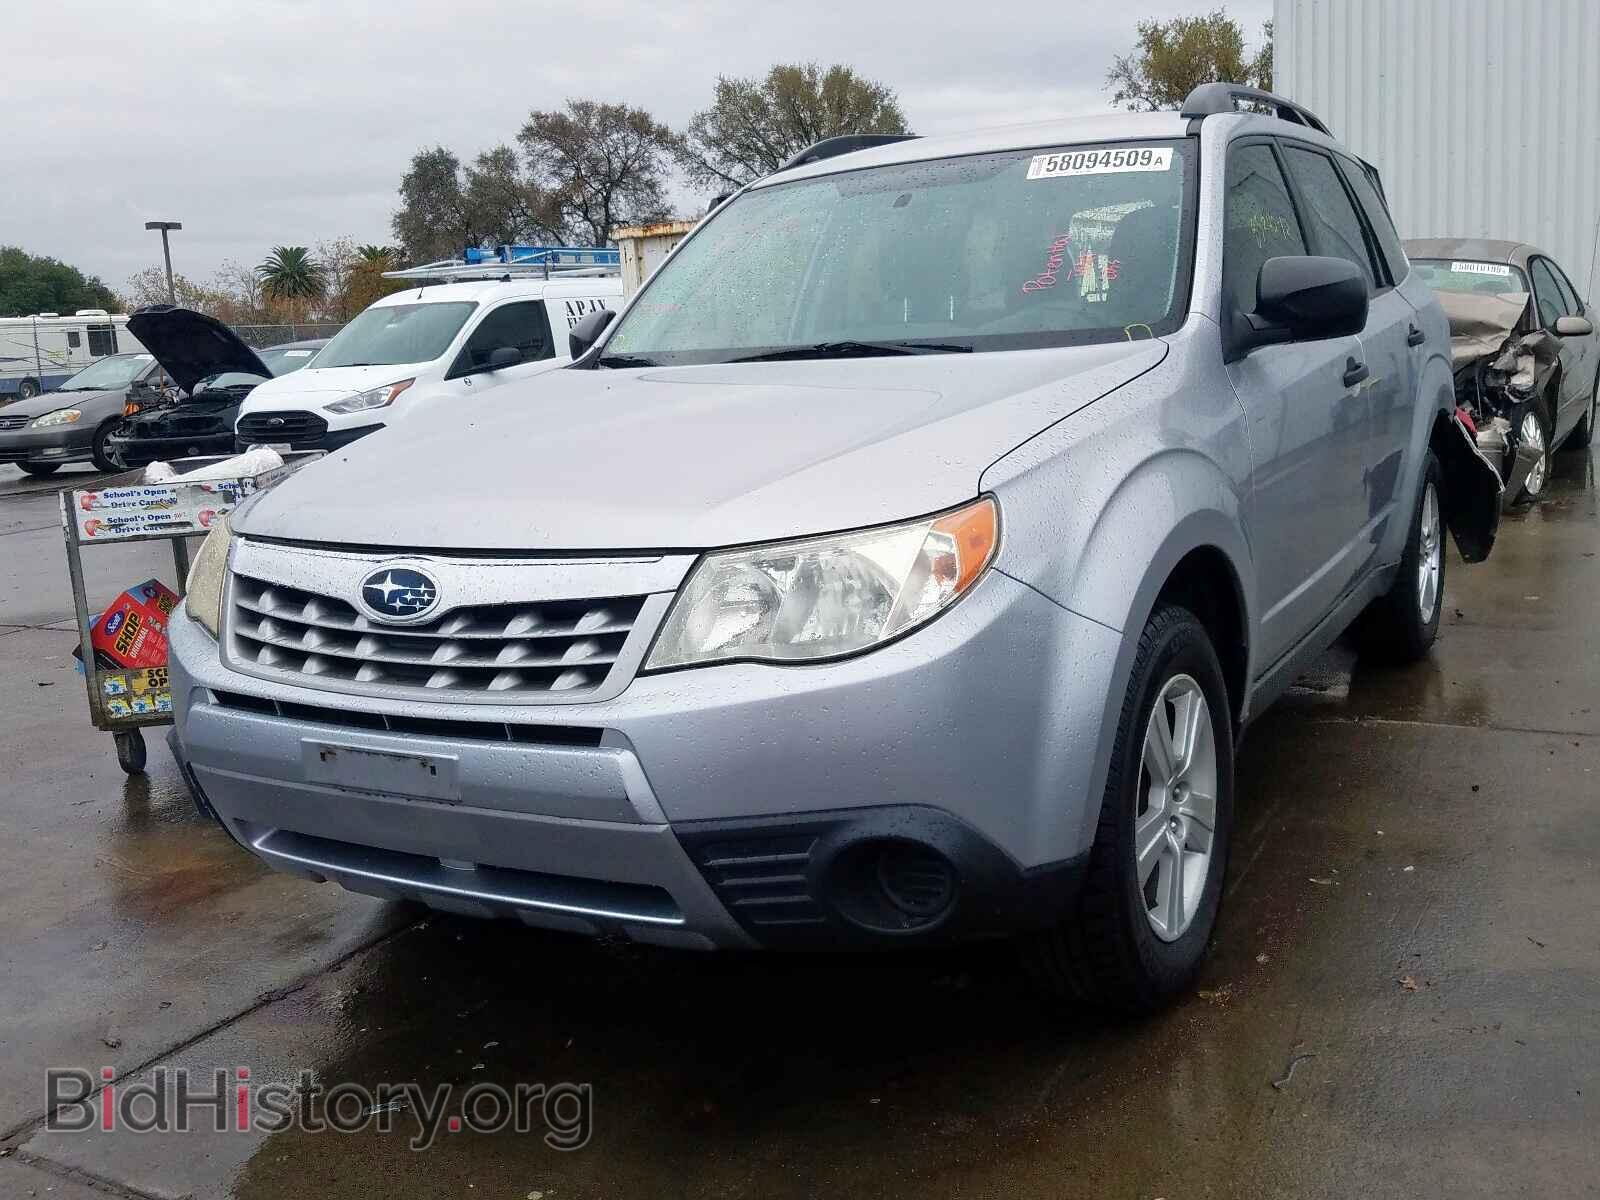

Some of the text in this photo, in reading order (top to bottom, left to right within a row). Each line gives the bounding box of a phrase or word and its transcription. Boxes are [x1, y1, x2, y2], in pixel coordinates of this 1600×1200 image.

[1046, 150, 1153, 172] 58094509
[1153, 156, 1164, 167] A
[103, 489, 141, 499] School's
[143, 488, 168, 497] Open
[111, 500, 137, 509] Drive
[107, 515, 145, 524] School's
[147, 513, 172, 522] Open
[115, 526, 141, 534] Drive
[115, 612, 140, 656] SHOP
